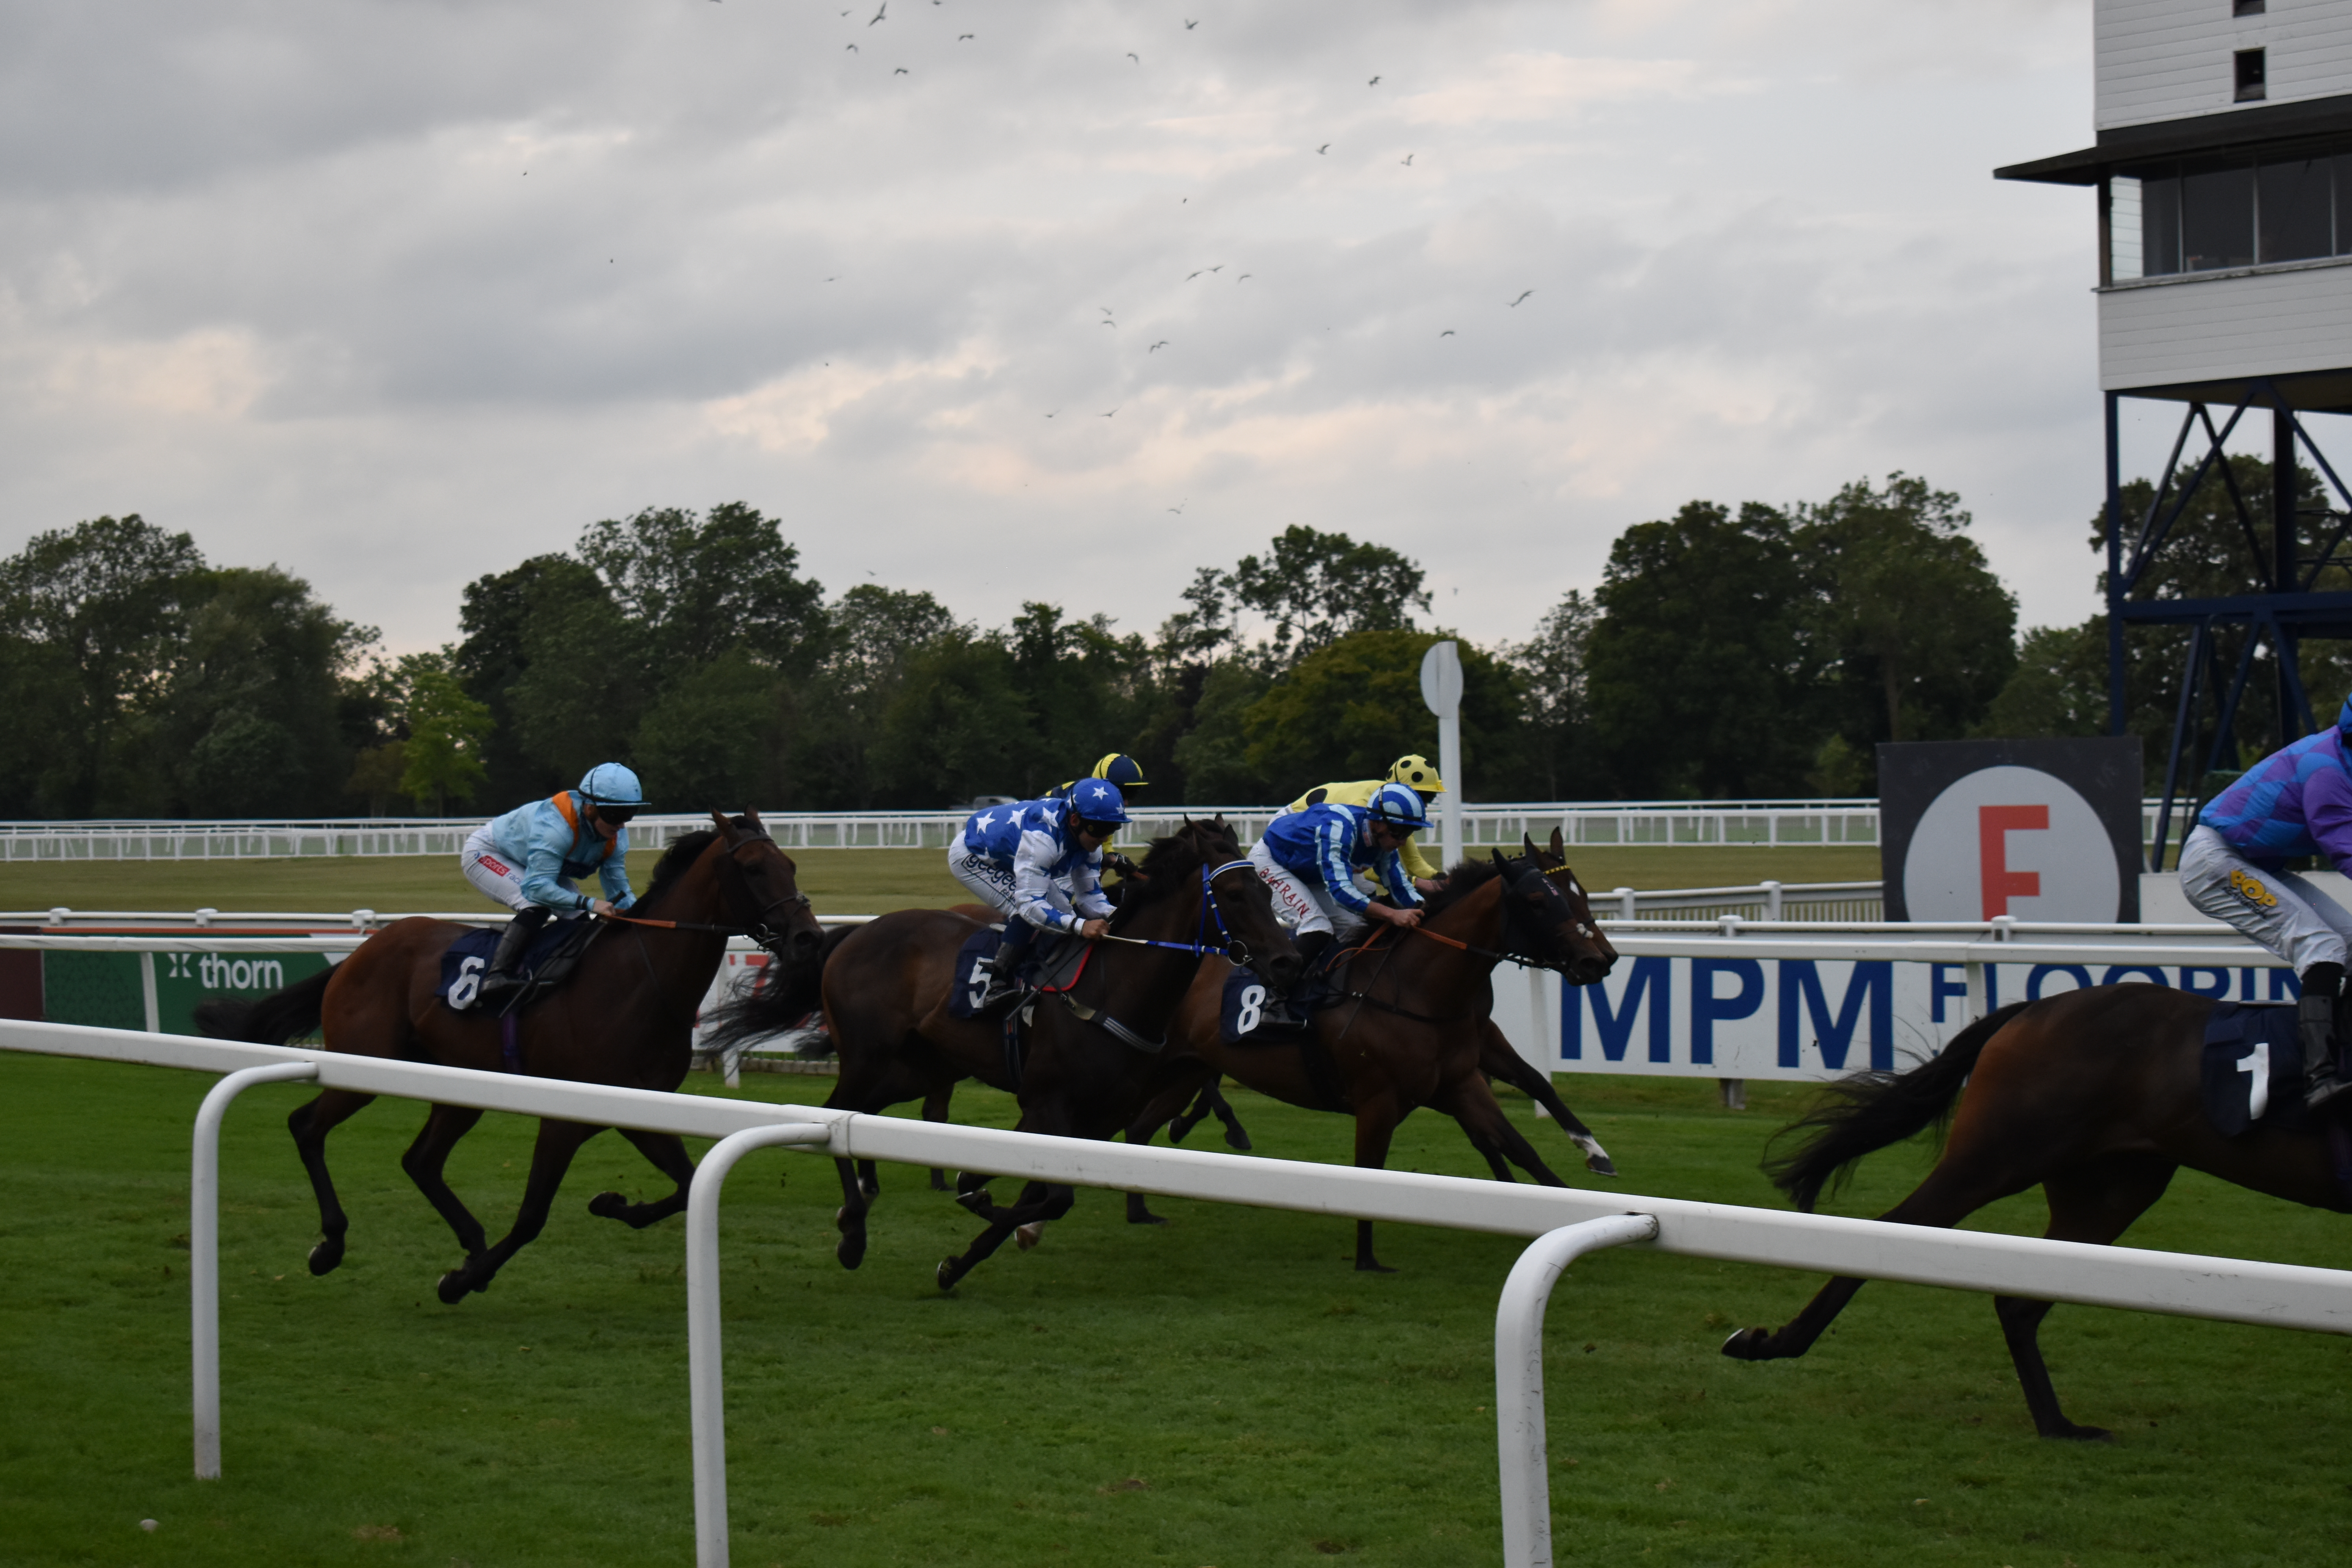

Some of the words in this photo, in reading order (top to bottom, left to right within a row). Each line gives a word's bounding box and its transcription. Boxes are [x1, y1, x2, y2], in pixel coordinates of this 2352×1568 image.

[1979, 804, 2049, 922] F
[2230, 870, 2278, 907] POP
[1259, 867, 1310, 919] BAHRAIN
[198, 952, 283, 989] thorn
[448, 956, 485, 1010] 6
[969, 956, 994, 1009] 5
[1237, 985, 1266, 1035] 8
[1561, 956, 1893, 1071] MPM
[2236, 1042, 2270, 1120] 1
